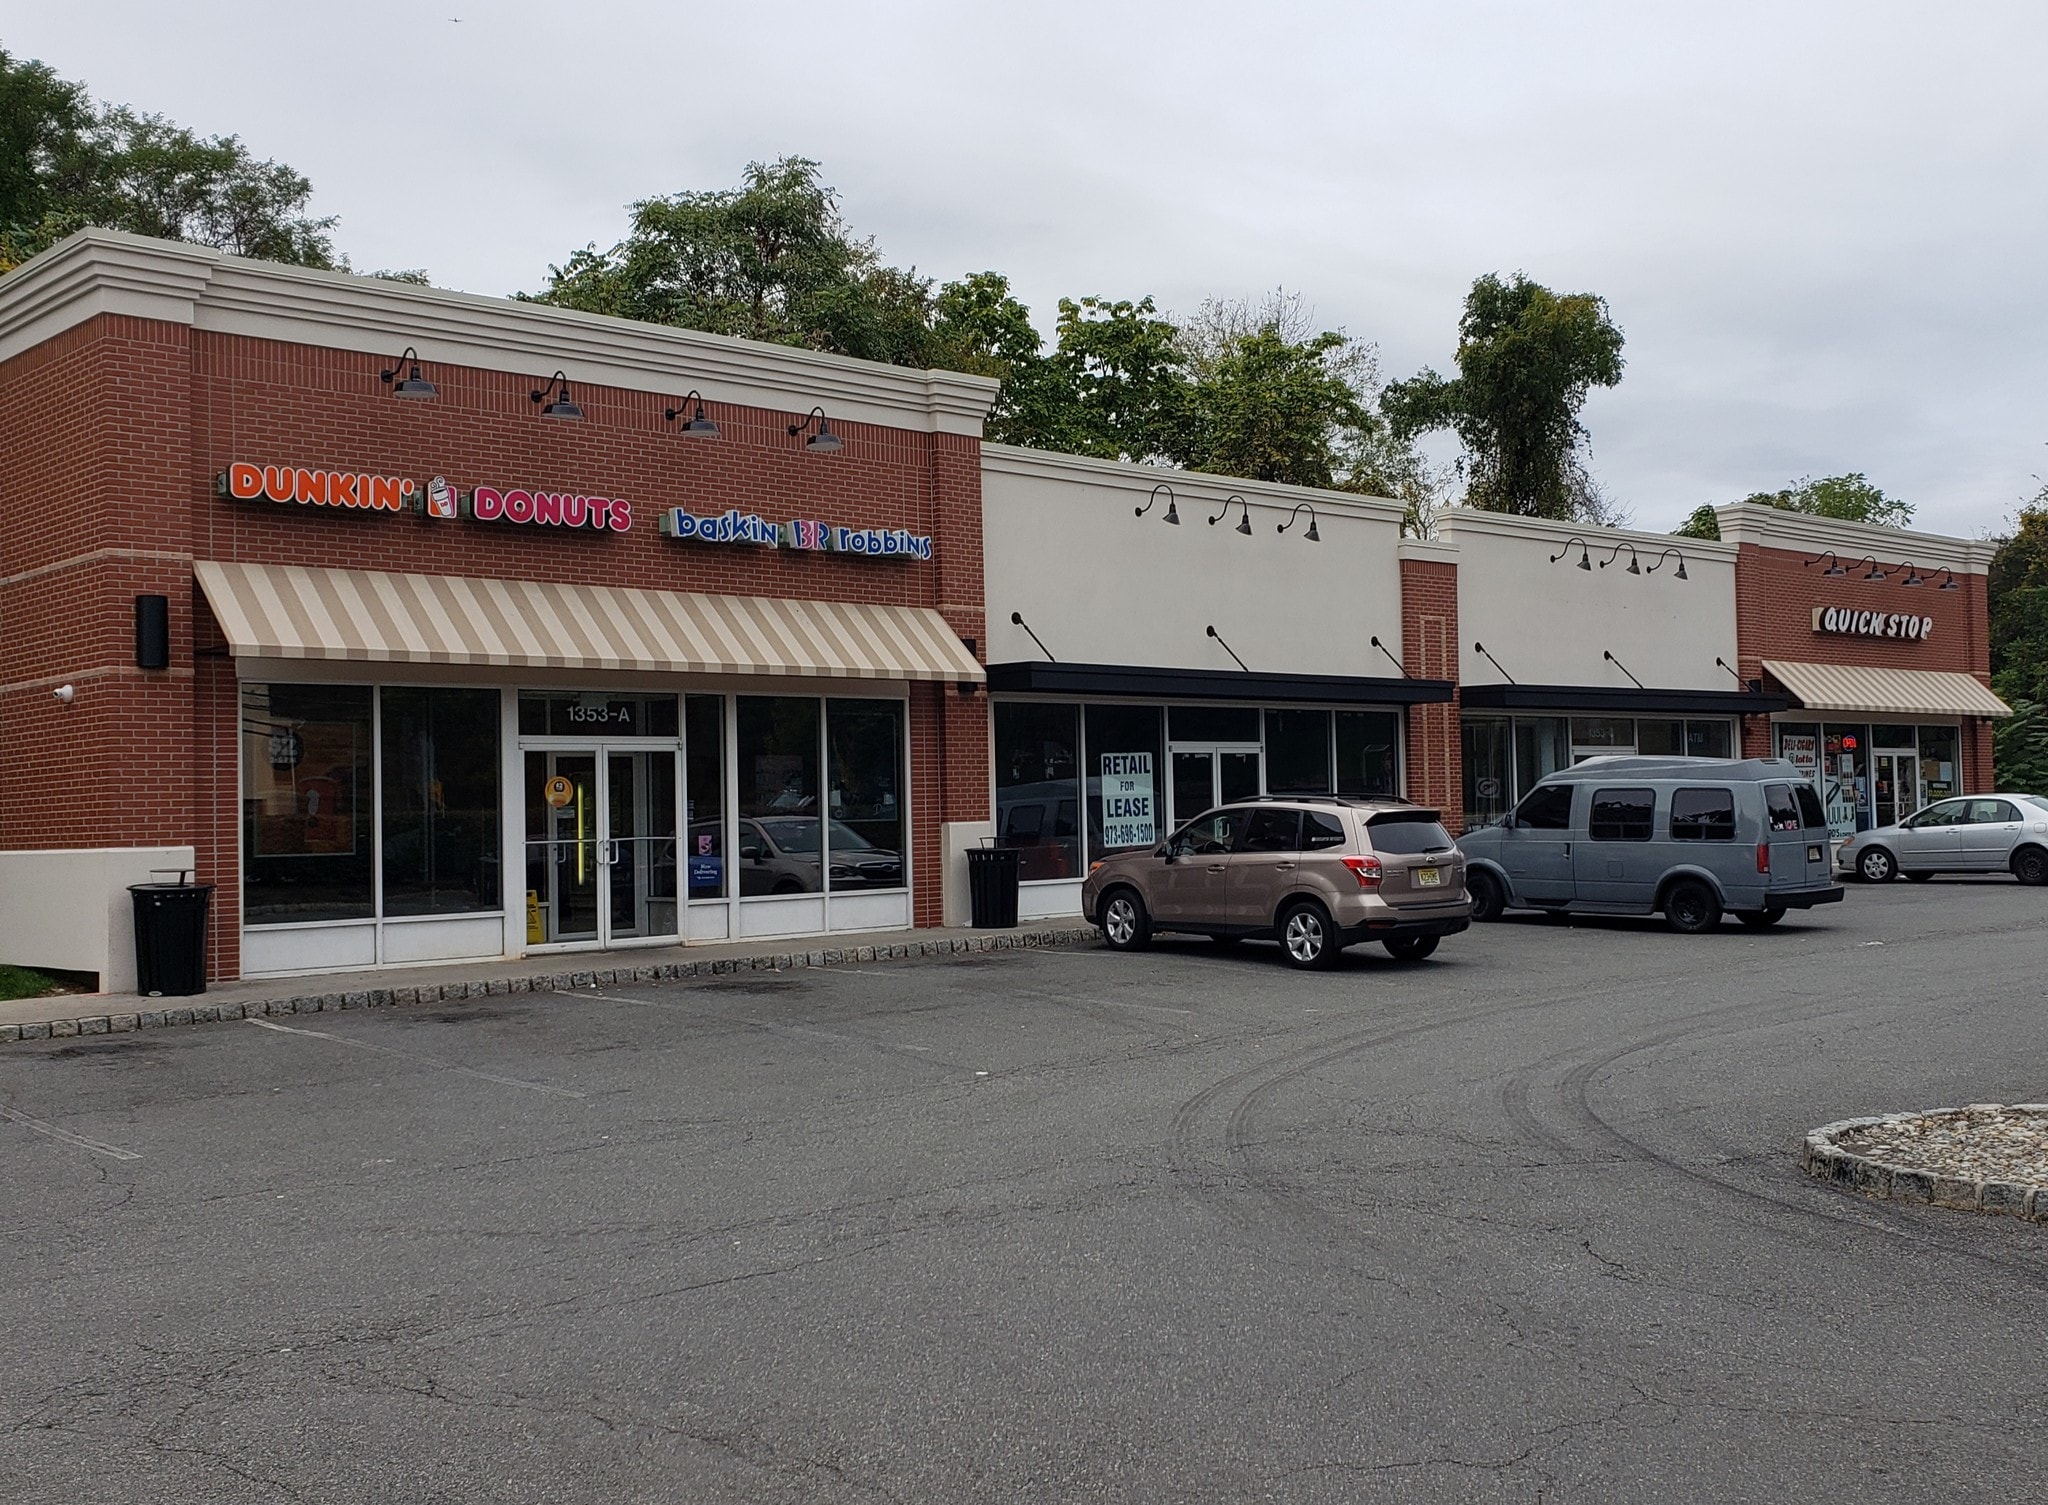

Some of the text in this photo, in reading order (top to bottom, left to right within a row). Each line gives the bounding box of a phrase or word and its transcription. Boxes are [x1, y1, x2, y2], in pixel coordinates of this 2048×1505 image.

[229, 462, 632, 533] DUNKIN' DONUTS
[676, 508, 932, 560] baskin BR robbins
[1824, 607, 1933, 639] QUICK STOP
[566, 705, 631, 722] 1353-A
[1103, 755, 1151, 775] RETAIL
[1795, 754, 1813, 764] lotto
[1120, 781, 1135, 791] FOR
[1107, 798, 1149, 818] LEASE
[1105, 823, 1153, 844] 973-696-1500
